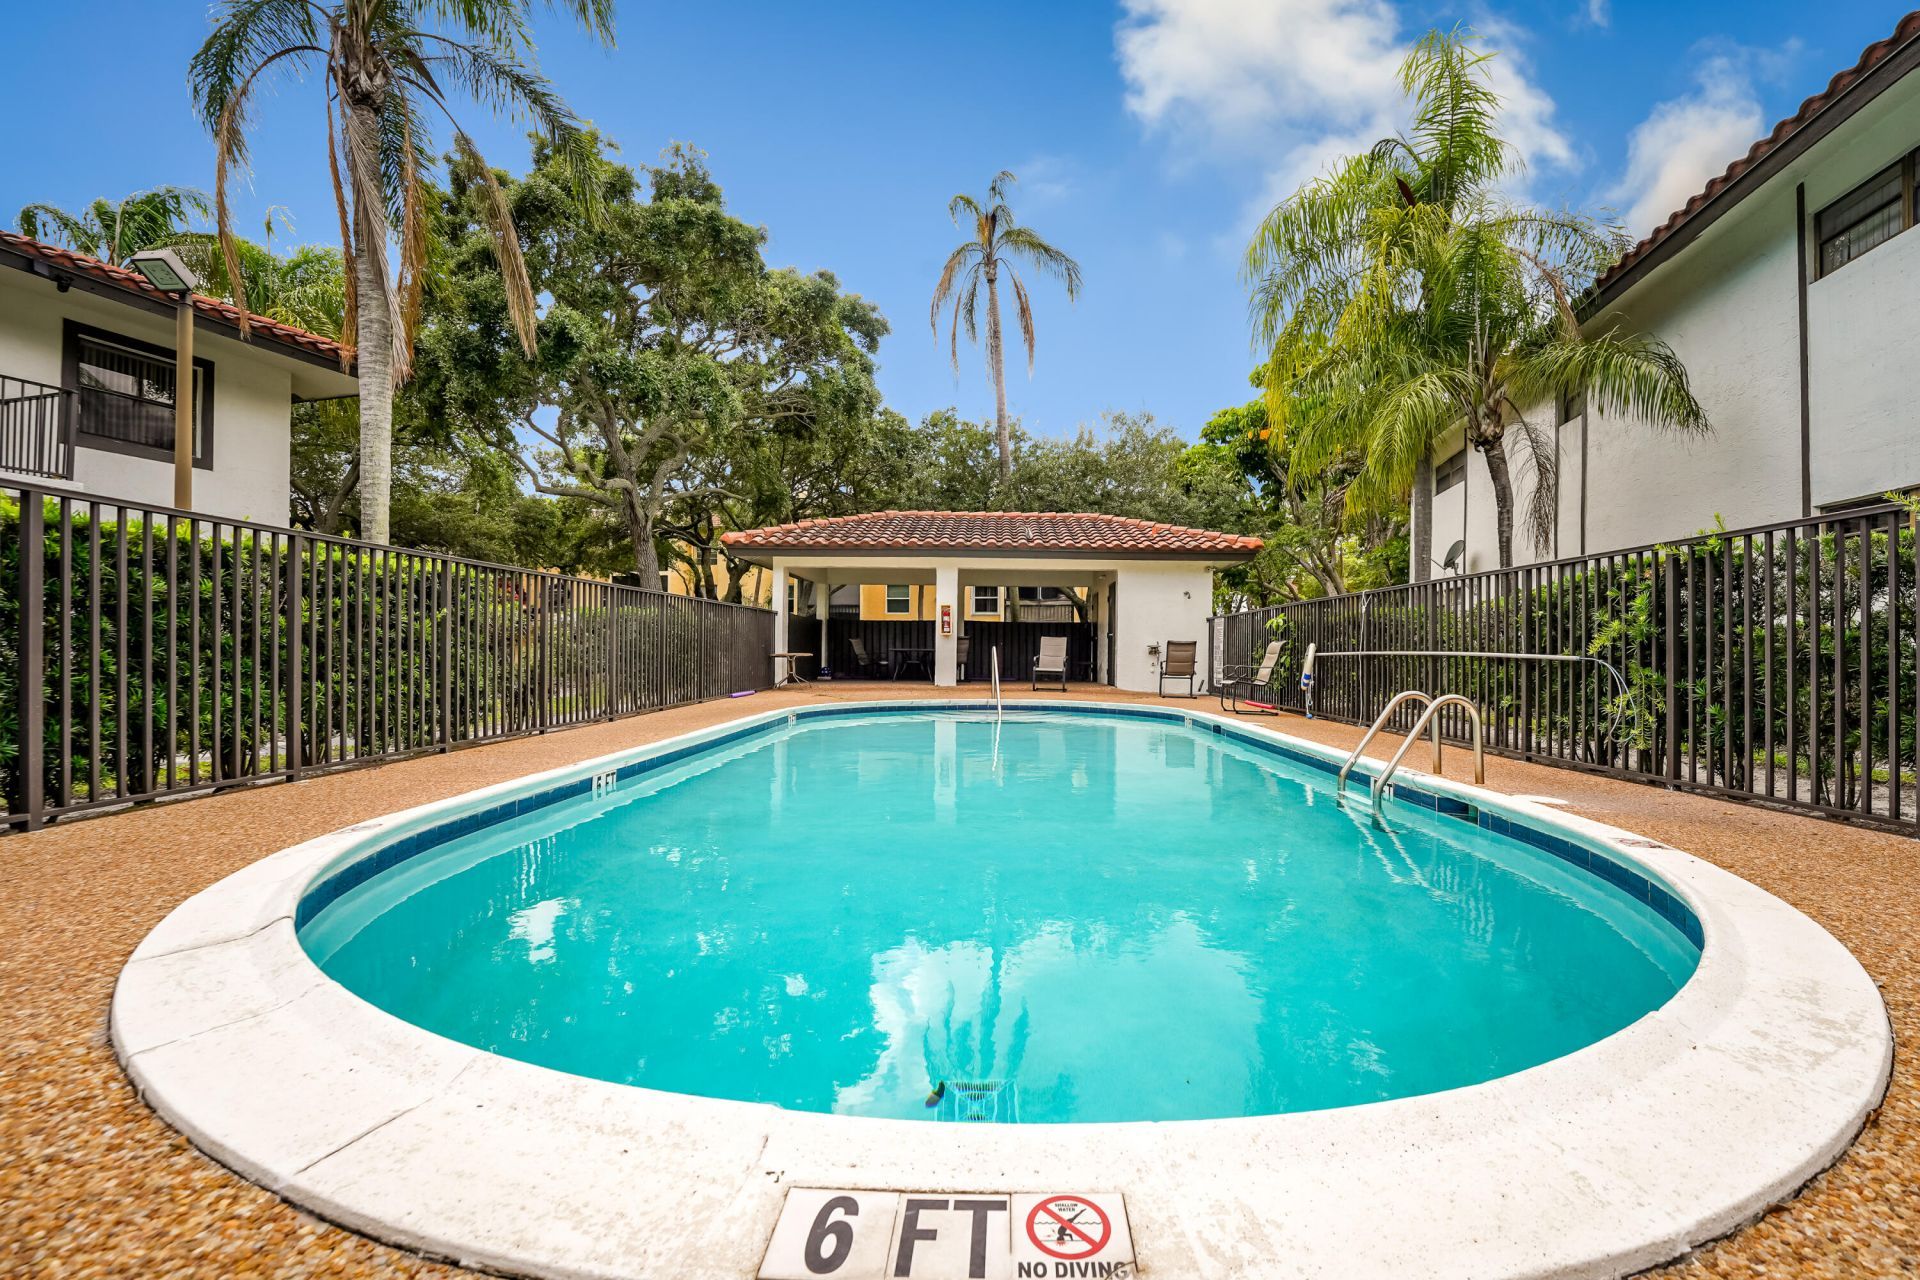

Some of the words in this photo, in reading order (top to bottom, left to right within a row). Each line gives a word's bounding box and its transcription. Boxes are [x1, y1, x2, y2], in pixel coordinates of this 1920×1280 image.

[804, 1196, 859, 1275] 6
[892, 1199, 1008, 1278] FT
[1018, 1261, 1048, 1279] NO
[1055, 1261, 1131, 1280] DIVING
